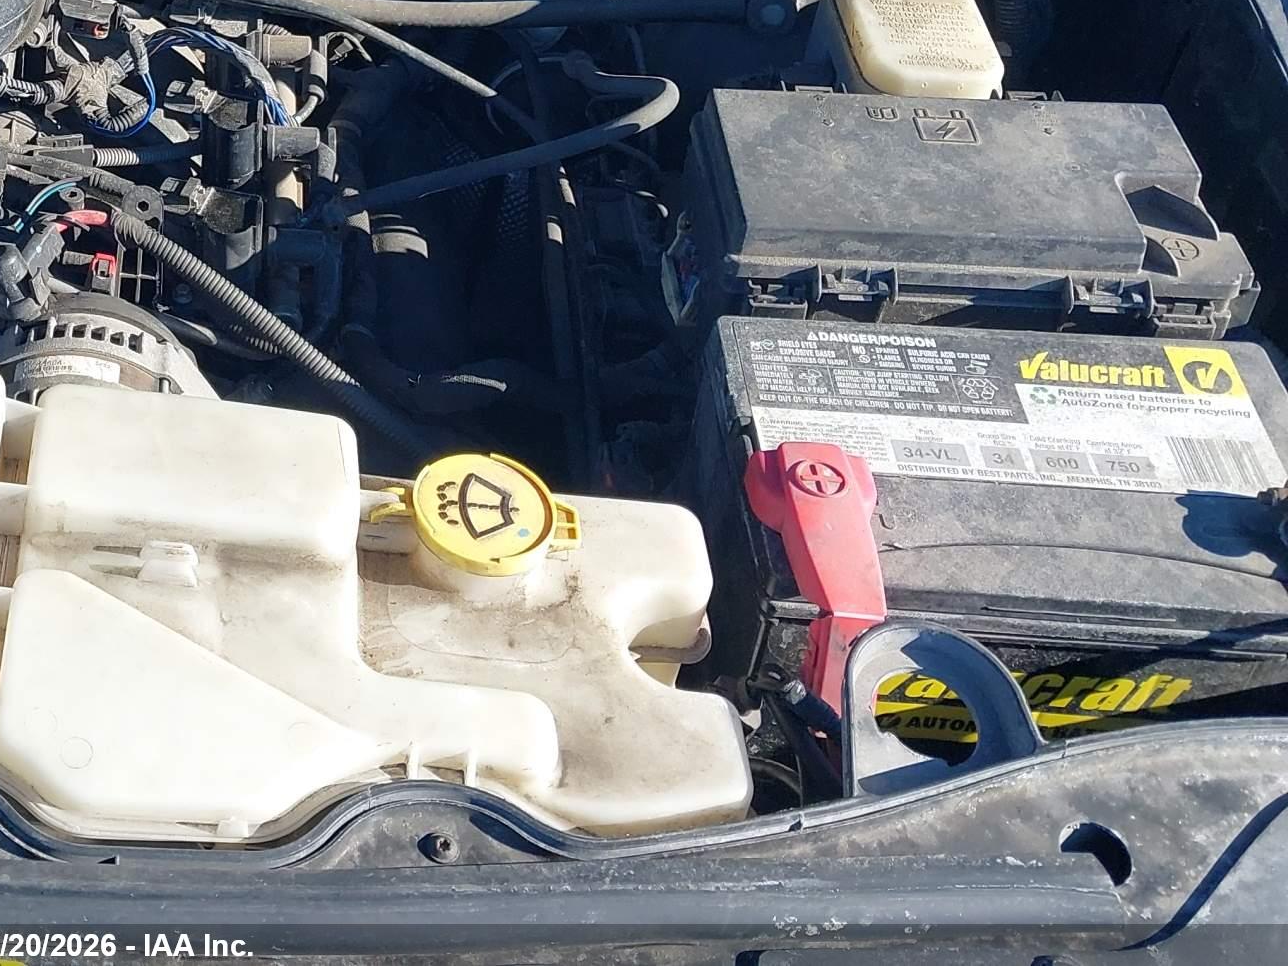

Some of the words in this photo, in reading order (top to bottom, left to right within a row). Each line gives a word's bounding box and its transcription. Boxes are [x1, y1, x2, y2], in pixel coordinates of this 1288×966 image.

[802, 340, 818, 349] EYES
[818, 332, 936, 348] DANGER/POISON
[780, 348, 814, 356] EXPLOSIVE
[852, 346, 866, 354] NO
[940, 350, 956, 358] ACID
[1018, 351, 1170, 388] Valucraft
[759, 394, 777, 402] KEEP
[820, 398, 844, 406] REACH
[894, 402, 904, 410] DO
[1058, 388, 1102, 399] Return
[1105, 392, 1135, 402] used
[1139, 394, 1195, 406] batteries
[1198, 397, 1212, 406] to
[1062, 398, 1124, 410] AutoZone
[1127, 402, 1142, 411] for
[1148, 404, 1190, 416] proper
[1193, 406, 1251, 419] recycling
[992, 453, 1014, 464] 34
[1046, 457, 1079, 470] 600
[897, 465, 958, 474] DISTRIBUTED
[1105, 460, 1140, 473] 750
